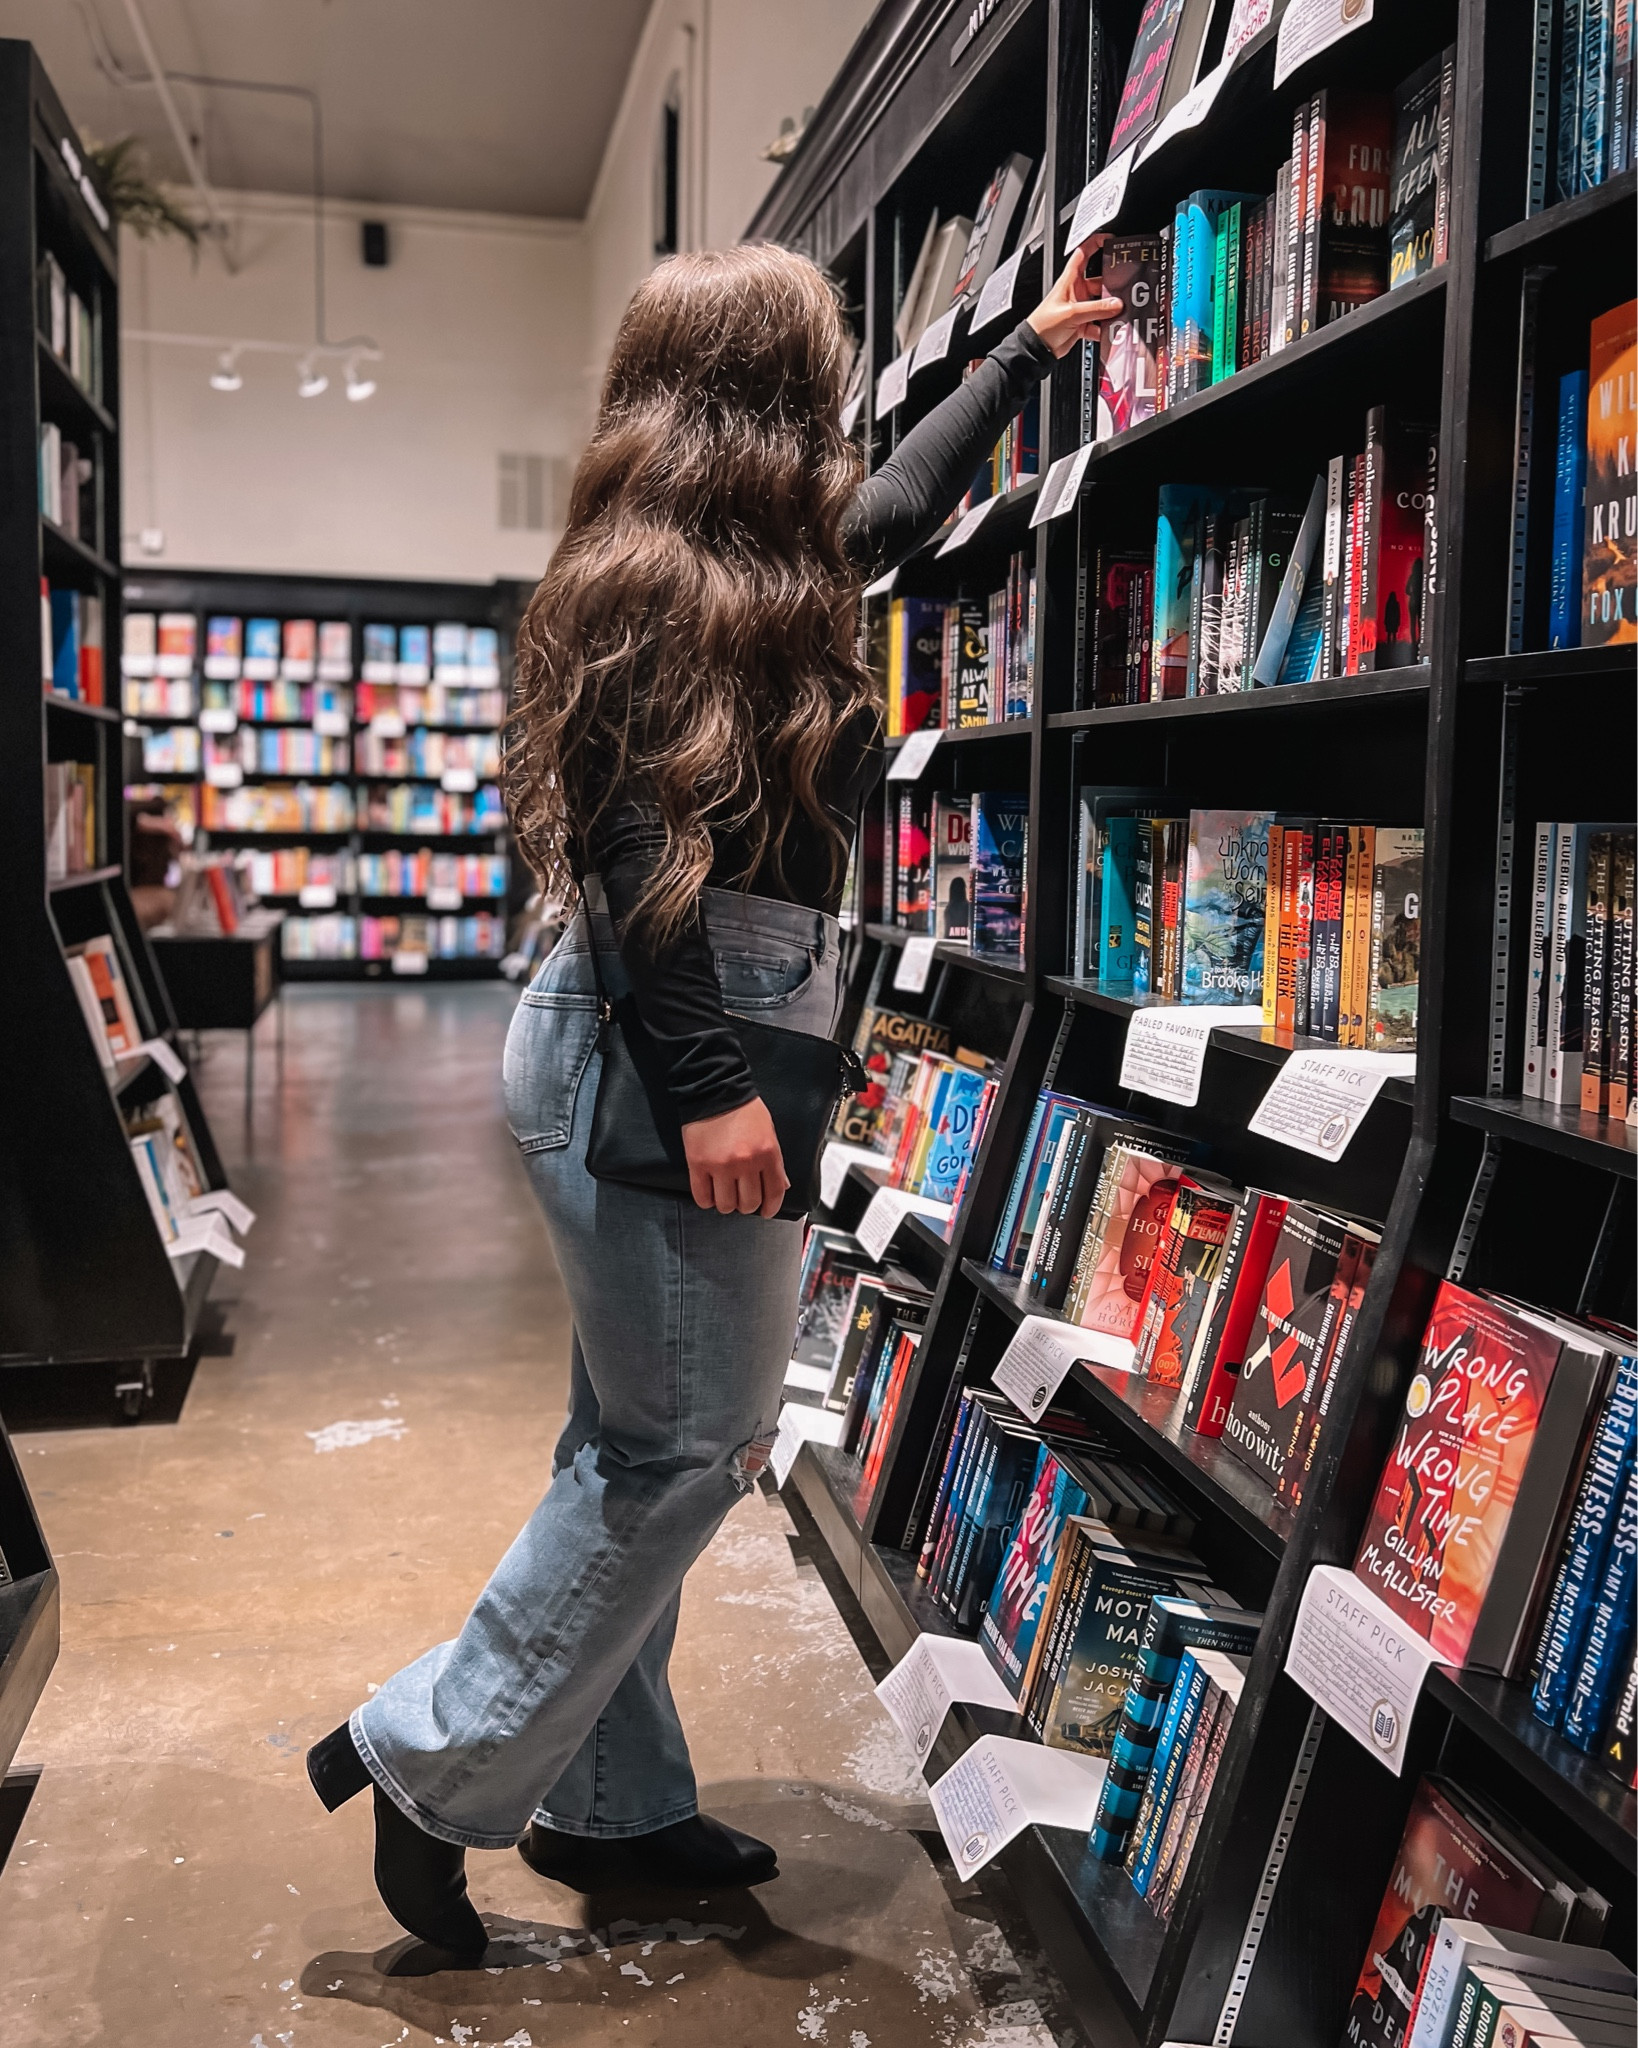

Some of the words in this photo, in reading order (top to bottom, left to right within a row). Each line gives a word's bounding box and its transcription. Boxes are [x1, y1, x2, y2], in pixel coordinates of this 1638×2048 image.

[1136, 36, 1174, 96] PARIS
[1290, 112, 1303, 183] FORSAKEN
[1307, 98, 1320, 170] FORSAKEN
[1287, 185, 1299, 246] COUNTRY
[1304, 172, 1317, 235] COUNTRY
[1110, 250, 1133, 269] J.T.
[1159, 237, 1167, 270] GOOD
[1158, 276, 1166, 310] GIRLS
[1365, 424, 1375, 449] the
[1329, 467, 1338, 506] TANA
[1357, 461, 1365, 489] LISA
[1363, 453, 1375, 523] collective
[1355, 492, 1365, 547] GARDNER
[1327, 512, 1336, 566] FRENCH
[1353, 551, 1362, 574] ONE
[1324, 593, 1332, 616] THE
[1352, 579, 1360, 608] STEP
[1590, 588, 1623, 625] FOX
[1351, 613, 1359, 635] TOO
[1321, 620, 1331, 679] LIKENESS
[1350, 639, 1358, 661] FAR
[962, 684, 977, 700] AT
[1271, 836, 1279, 868] PAULA
[1284, 842, 1293, 866] EMMA
[1300, 833, 1313, 883] DEAR
[1534, 834, 1549, 897] BLUEBIRD,
[1556, 835, 1571, 898] BLUEBIRD,
[992, 867, 1021, 878] WHEN
[1283, 868, 1292, 912] HAUGHTON
[1596, 859, 1606, 894] THE
[1624, 863, 1634, 899] THE
[1269, 872, 1277, 918] HAWKINS
[1372, 890, 1382, 930] GUIDE
[1279, 922, 1291, 949] THE
[1296, 903, 1311, 960] CHILD
[1531, 900, 1545, 959] BLUEBIRD
[1554, 902, 1568, 962] BLUEBIRD
[1584, 909, 1595, 959] ATTICA
[1591, 900, 1605, 981] CUTTING
[1612, 915, 1622, 966] ATTICA
[1620, 905, 1633, 988] CUTTING
[1371, 938, 1380, 970] PETER
[1202, 971, 1250, 989] Brooks
[1277, 956, 1290, 998] DARK
[1369, 973, 1378, 1009] HELLER
[1582, 965, 1592, 1010] LOCKE
[1611, 972, 1621, 1018] LOCKE
[872, 1013, 951, 1053] AGATHA
[1134, 1015, 1163, 1030] FABLED
[1165, 1022, 1205, 1040] FAVORITE
[1589, 986, 1603, 1052] SEASON
[1618, 993, 1631, 1061] SEASON
[1301, 1059, 1336, 1077] STAFF
[1336, 1068, 1367, 1087] PICK
[1064, 1152, 1070, 1160] A
[1066, 1128, 1077, 1152] WITH
[1076, 1133, 1086, 1157] WITH
[1054, 1183, 1062, 1196] TO
[1058, 1159, 1068, 1183] MIND
[1067, 1164, 1078, 1188] MIND
[1049, 1196, 1059, 1216] KILL
[1058, 1201, 1068, 1222] KILL
[1063, 1188, 1071, 1202] TO
[1239, 1208, 1247, 1217] A
[1268, 1209, 1281, 1217] NEW
[1046, 1230, 1062, 1272] ANTHONY
[1230, 1219, 1244, 1247] LINE
[1226, 1248, 1236, 1264] TO
[1218, 1265, 1232, 1291] KILL
[896, 1307, 917, 1322] THE
[1316, 1302, 1334, 1346] CATHERINE
[1029, 1326, 1050, 1346] STAFF
[1048, 1343, 1065, 1361] PICK
[1334, 1312, 1352, 1357] CATHERINE
[1158, 1359, 1176, 1371] 007
[1310, 1345, 1323, 1367] RYAN
[1328, 1355, 1340, 1379] RYAN
[1424, 1325, 1529, 1402] WRONG
[1301, 1366, 1316, 1404] HOWARD
[1318, 1378, 1334, 1416] HOWARD
[1248, 1409, 1272, 1433] anthony
[1428, 1377, 1519, 1444] PLACE
[1225, 1401, 1286, 1476] horowitz
[1286, 1409, 1304, 1459] REWIND
[1303, 1422, 1321, 1472] REWIND
[1396, 1424, 1492, 1511] WRONG
[1579, 1381, 1637, 1536] BREATHLESS
[1021, 1490, 1062, 1567] RUN
[1419, 1485, 1483, 1551] TIME
[1070, 1536, 1081, 1562] TOTAL
[1078, 1545, 1089, 1571] TOTAL
[1384, 1525, 1445, 1581] GILLIAN
[1568, 1543, 1590, 1581] AMY
[998, 1540, 1049, 1621] TIME
[1062, 1562, 1075, 1593] CHAOS
[1069, 1571, 1083, 1602] CHAOS
[1101, 1584, 1125, 1594] Revenge
[1360, 1544, 1457, 1626] McALLISTER
[1094, 1595, 1149, 1621] MOT
[1326, 1588, 1369, 1629] STAFF
[1370, 1624, 1406, 1663] PICK
[1053, 1607, 1073, 1662] JEAN-CLAUDE
[1105, 1623, 1139, 1646] MA
[1140, 1613, 1159, 1650] LISA
[1201, 1627, 1216, 1636] YORK
[1216, 1629, 1234, 1639] TIMES
[1544, 1580, 1580, 1674] McCULLOCH
[918, 1649, 935, 1678] STAFF
[931, 1674, 945, 1701] PICK
[1048, 1661, 1059, 1681] IZZO
[1085, 1661, 1133, 1680] JOSH
[1122, 1653, 1148, 1716] JEWELL
[1188, 1671, 1203, 1699] LISA
[1083, 1680, 1129, 1699] JACK
[1117, 1722, 1127, 1740] THE
[1177, 1697, 1196, 1738] JEWELL
[1107, 1741, 1121, 1777] FAMILY
[1171, 1740, 1182, 1760] THE
[982, 1752, 1002, 1788] STAFF
[1000, 1785, 1019, 1816] PICK
[1146, 1766, 1159, 1794] LISA
[1163, 1759, 1177, 1787] NIGHT
[1095, 1777, 1112, 1823] REMAINS
[1158, 1787, 1168, 1805] SHE
[1132, 1796, 1151, 1843] JEWELL
[1140, 1804, 1163, 1866] DISAPPEARED
[1170, 1803, 1182, 1830] LISA
[1183, 1819, 1196, 1848] LISA
[1155, 1833, 1173, 1881] JEWELL
[1168, 1851, 1187, 1899] JEWELL
[1431, 1851, 1481, 1922] THE
[1419, 1967, 1438, 2017] DEAD
[1424, 1965, 1449, 2038] FROZEN
